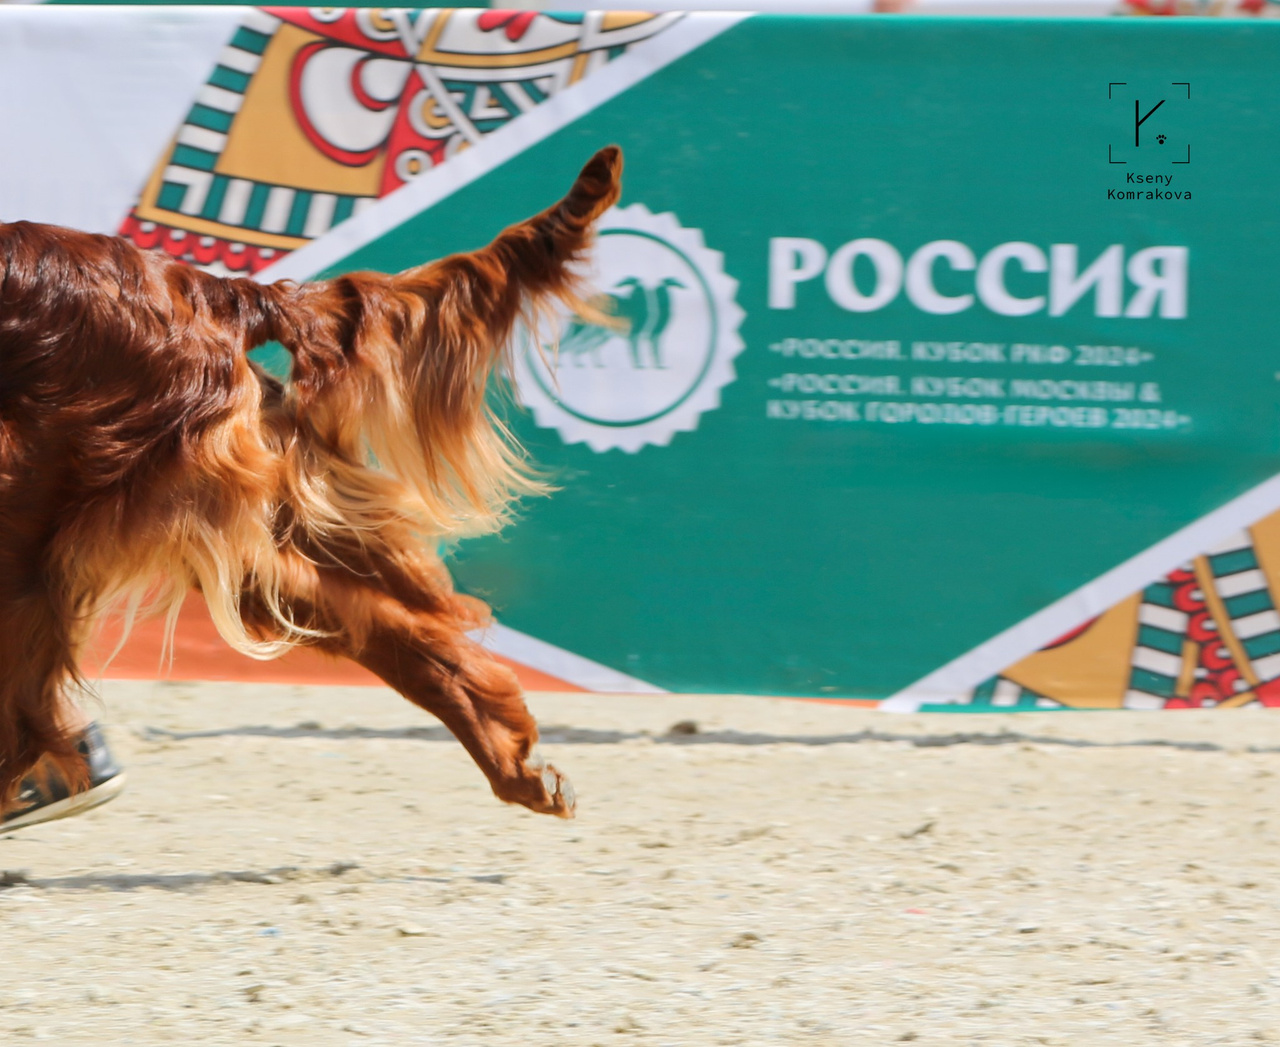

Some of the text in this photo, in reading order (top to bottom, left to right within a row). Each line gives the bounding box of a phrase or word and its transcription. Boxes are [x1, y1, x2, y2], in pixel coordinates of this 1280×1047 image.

[767, 236, 1190, 319] РОССИЯ
[910, 340, 1007, 364] КУБОК
[910, 376, 1007, 399] КУБОК
[1009, 378, 1136, 402] МОСКВЫ
[766, 399, 863, 421] КУБОК
